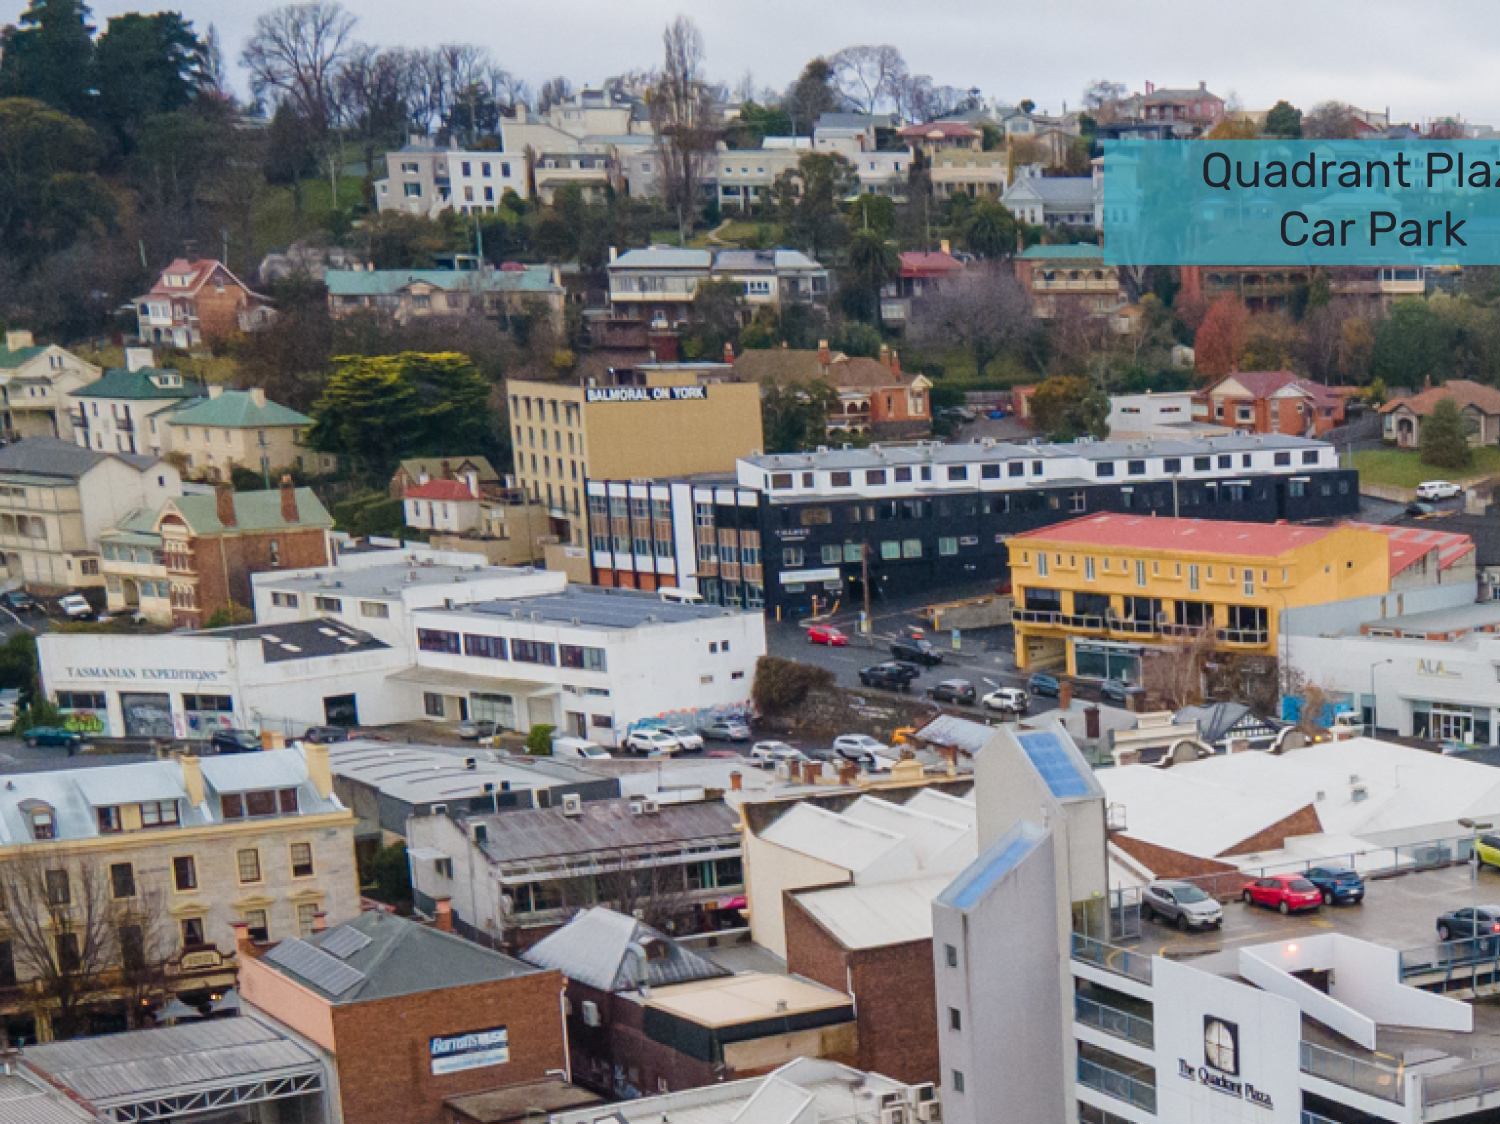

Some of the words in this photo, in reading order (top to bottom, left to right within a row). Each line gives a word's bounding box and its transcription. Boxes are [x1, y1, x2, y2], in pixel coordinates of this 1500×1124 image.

[587, 386, 648, 401] BALMORAL
[652, 386, 671, 400] ON
[673, 384, 705, 399] YORK
[66, 667, 137, 678] TASMANIAN
[141, 668, 218, 681] EXPEDITIONS
[1178, 1057, 1196, 1077] The
[1198, 1066, 1243, 1096] Quadrant
